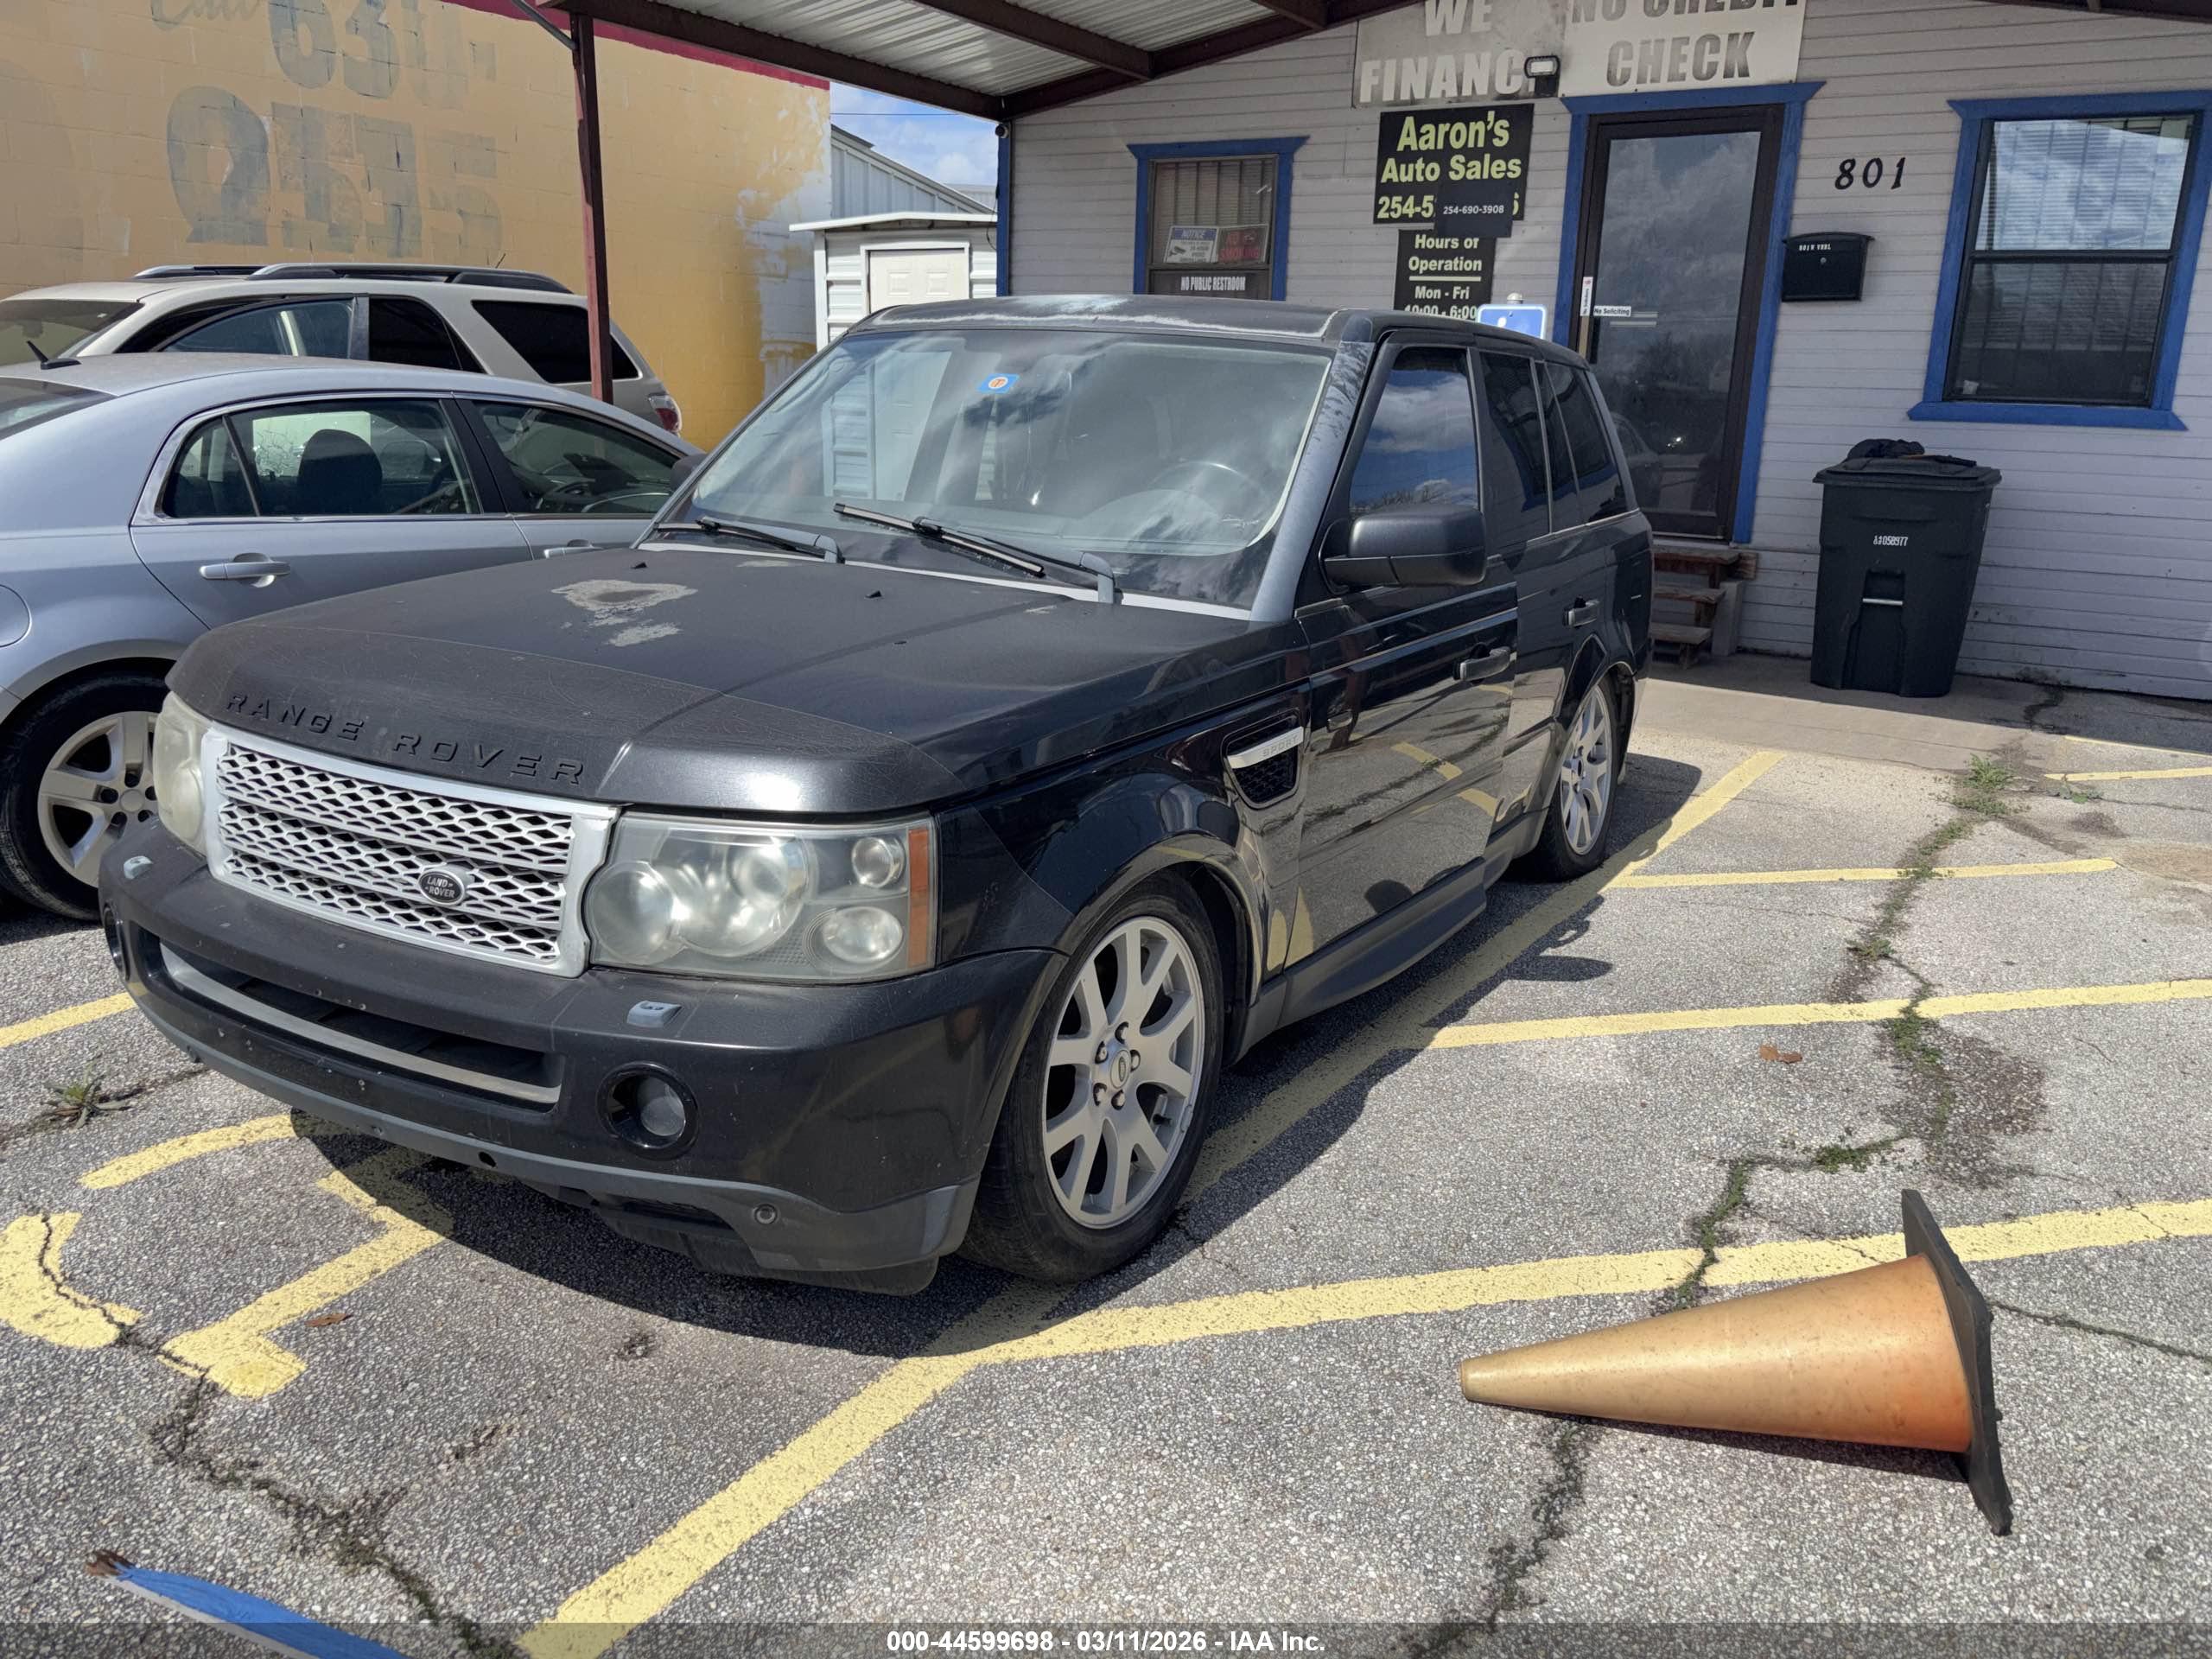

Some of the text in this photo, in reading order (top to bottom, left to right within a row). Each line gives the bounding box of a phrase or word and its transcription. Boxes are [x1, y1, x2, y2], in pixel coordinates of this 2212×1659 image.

[1606, 31, 1755, 87] CHECK
[1359, 48, 1536, 103] FINANC
[1396, 111, 1510, 151] Aaron's
[1381, 153, 1522, 183] Auto Sales
[1834, 157, 1905, 189] 801
[1443, 205, 1504, 214] 254-690-3908
[1414, 234, 1480, 249] Hours of
[1408, 256, 1482, 274] Operation
[1180, 276, 1246, 290] NO PUBLIC RESTROOM
[1414, 286, 1441, 299] Mon
[1452, 286, 1470, 299] Fri
[226, 693, 584, 785] RANGE ROVER
